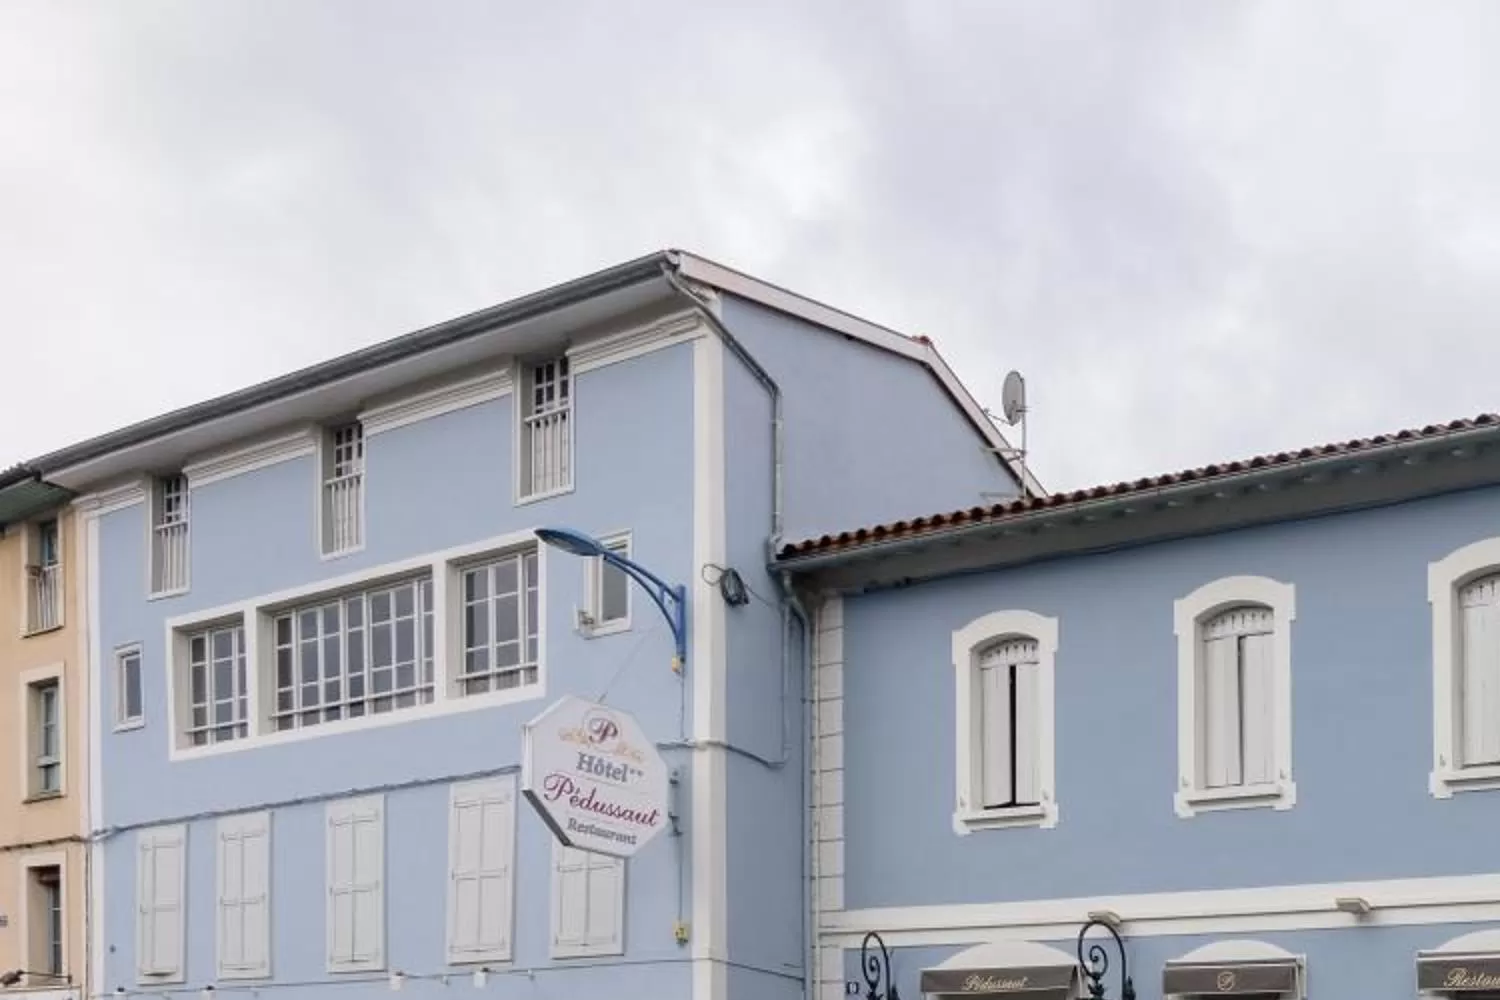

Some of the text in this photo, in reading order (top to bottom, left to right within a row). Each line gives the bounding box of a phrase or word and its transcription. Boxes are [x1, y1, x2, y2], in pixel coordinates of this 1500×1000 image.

[588, 717, 618, 744] P
[543, 770, 660, 827] Pédussaut
[567, 817, 638, 845] Restaurant
